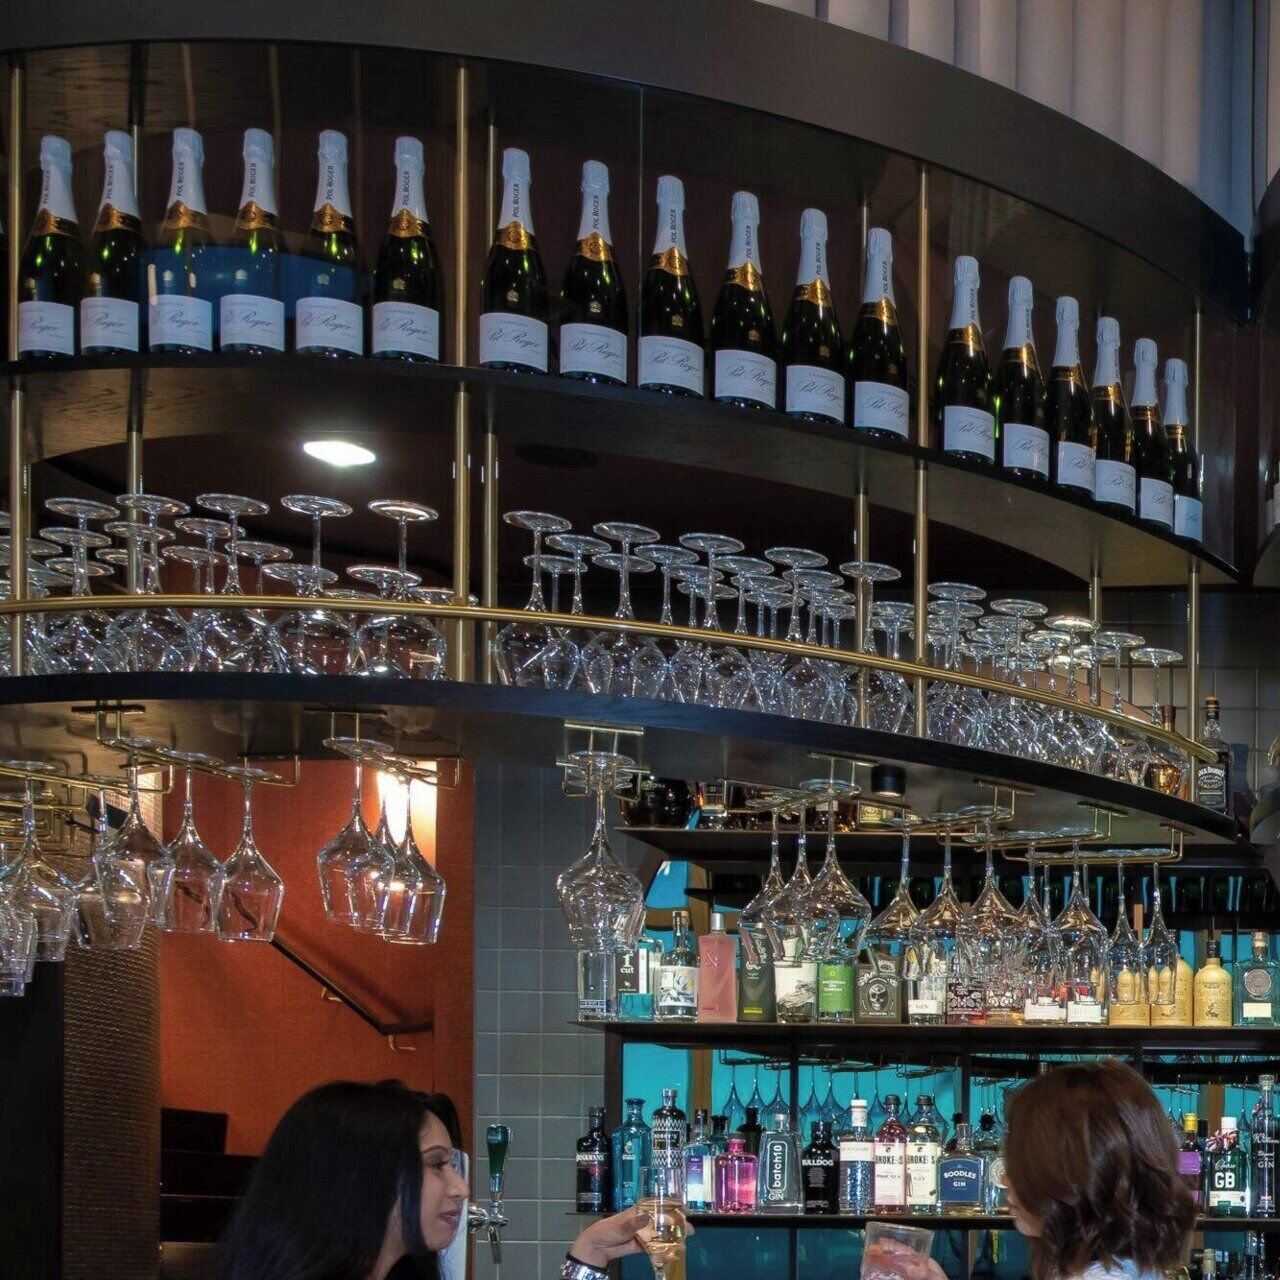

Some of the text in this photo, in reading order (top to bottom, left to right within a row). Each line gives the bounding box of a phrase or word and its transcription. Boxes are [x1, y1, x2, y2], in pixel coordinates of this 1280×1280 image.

[772, 1145, 782, 1188] batch10
[802, 1159, 834, 1167] BULLDOG
[943, 1169, 977, 1180] BOODLES
[1215, 1171, 1236, 1189] GB
[768, 1192, 784, 1201] GIN
